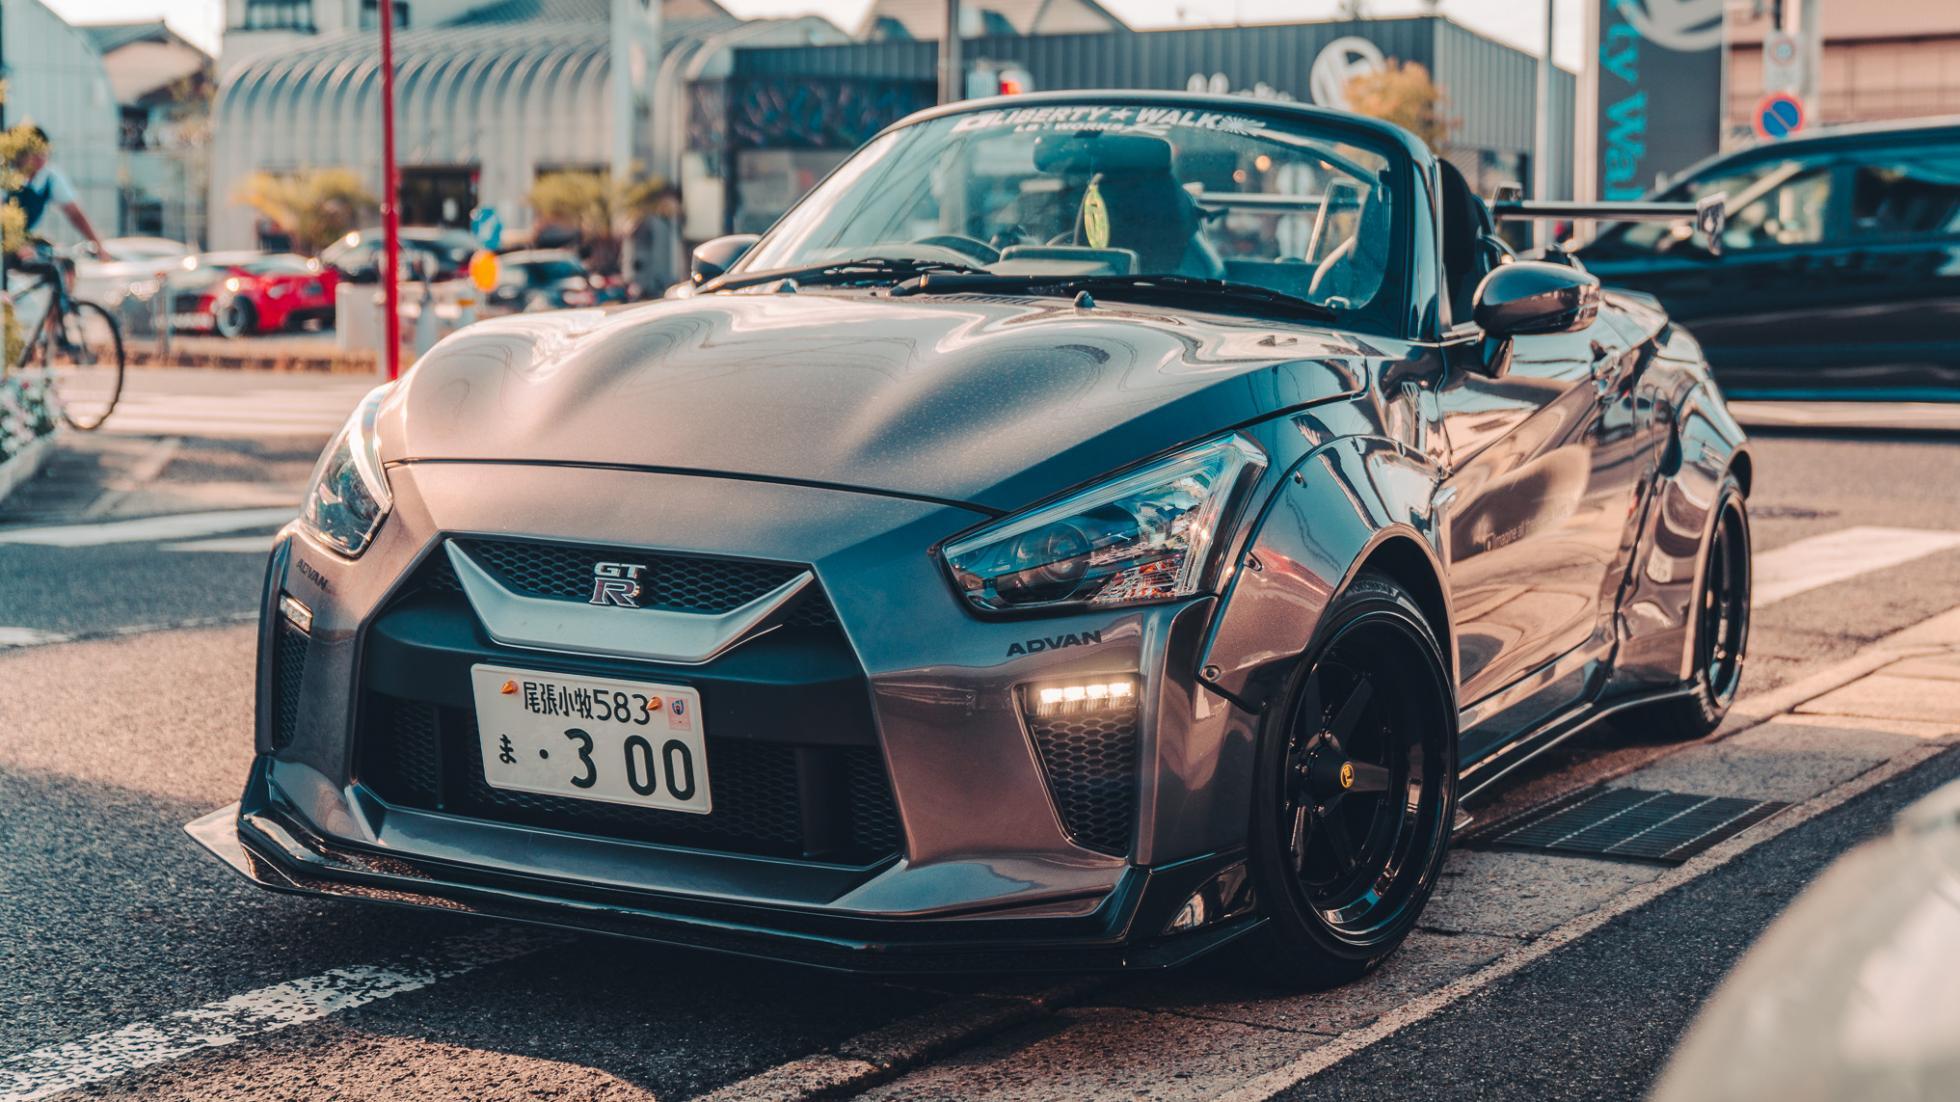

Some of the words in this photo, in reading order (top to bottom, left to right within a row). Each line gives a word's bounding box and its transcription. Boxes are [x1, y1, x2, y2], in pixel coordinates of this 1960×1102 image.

[1599, 0, 1640, 84] ty
[987, 106, 1110, 126] LIBERTY
[1136, 106, 1224, 129] WALK
[1605, 90, 1647, 200] Wal
[296, 558, 329, 591] ADVAN
[594, 561, 647, 579] GT
[589, 576, 640, 608] R
[1006, 629, 1102, 657] ADVAN
